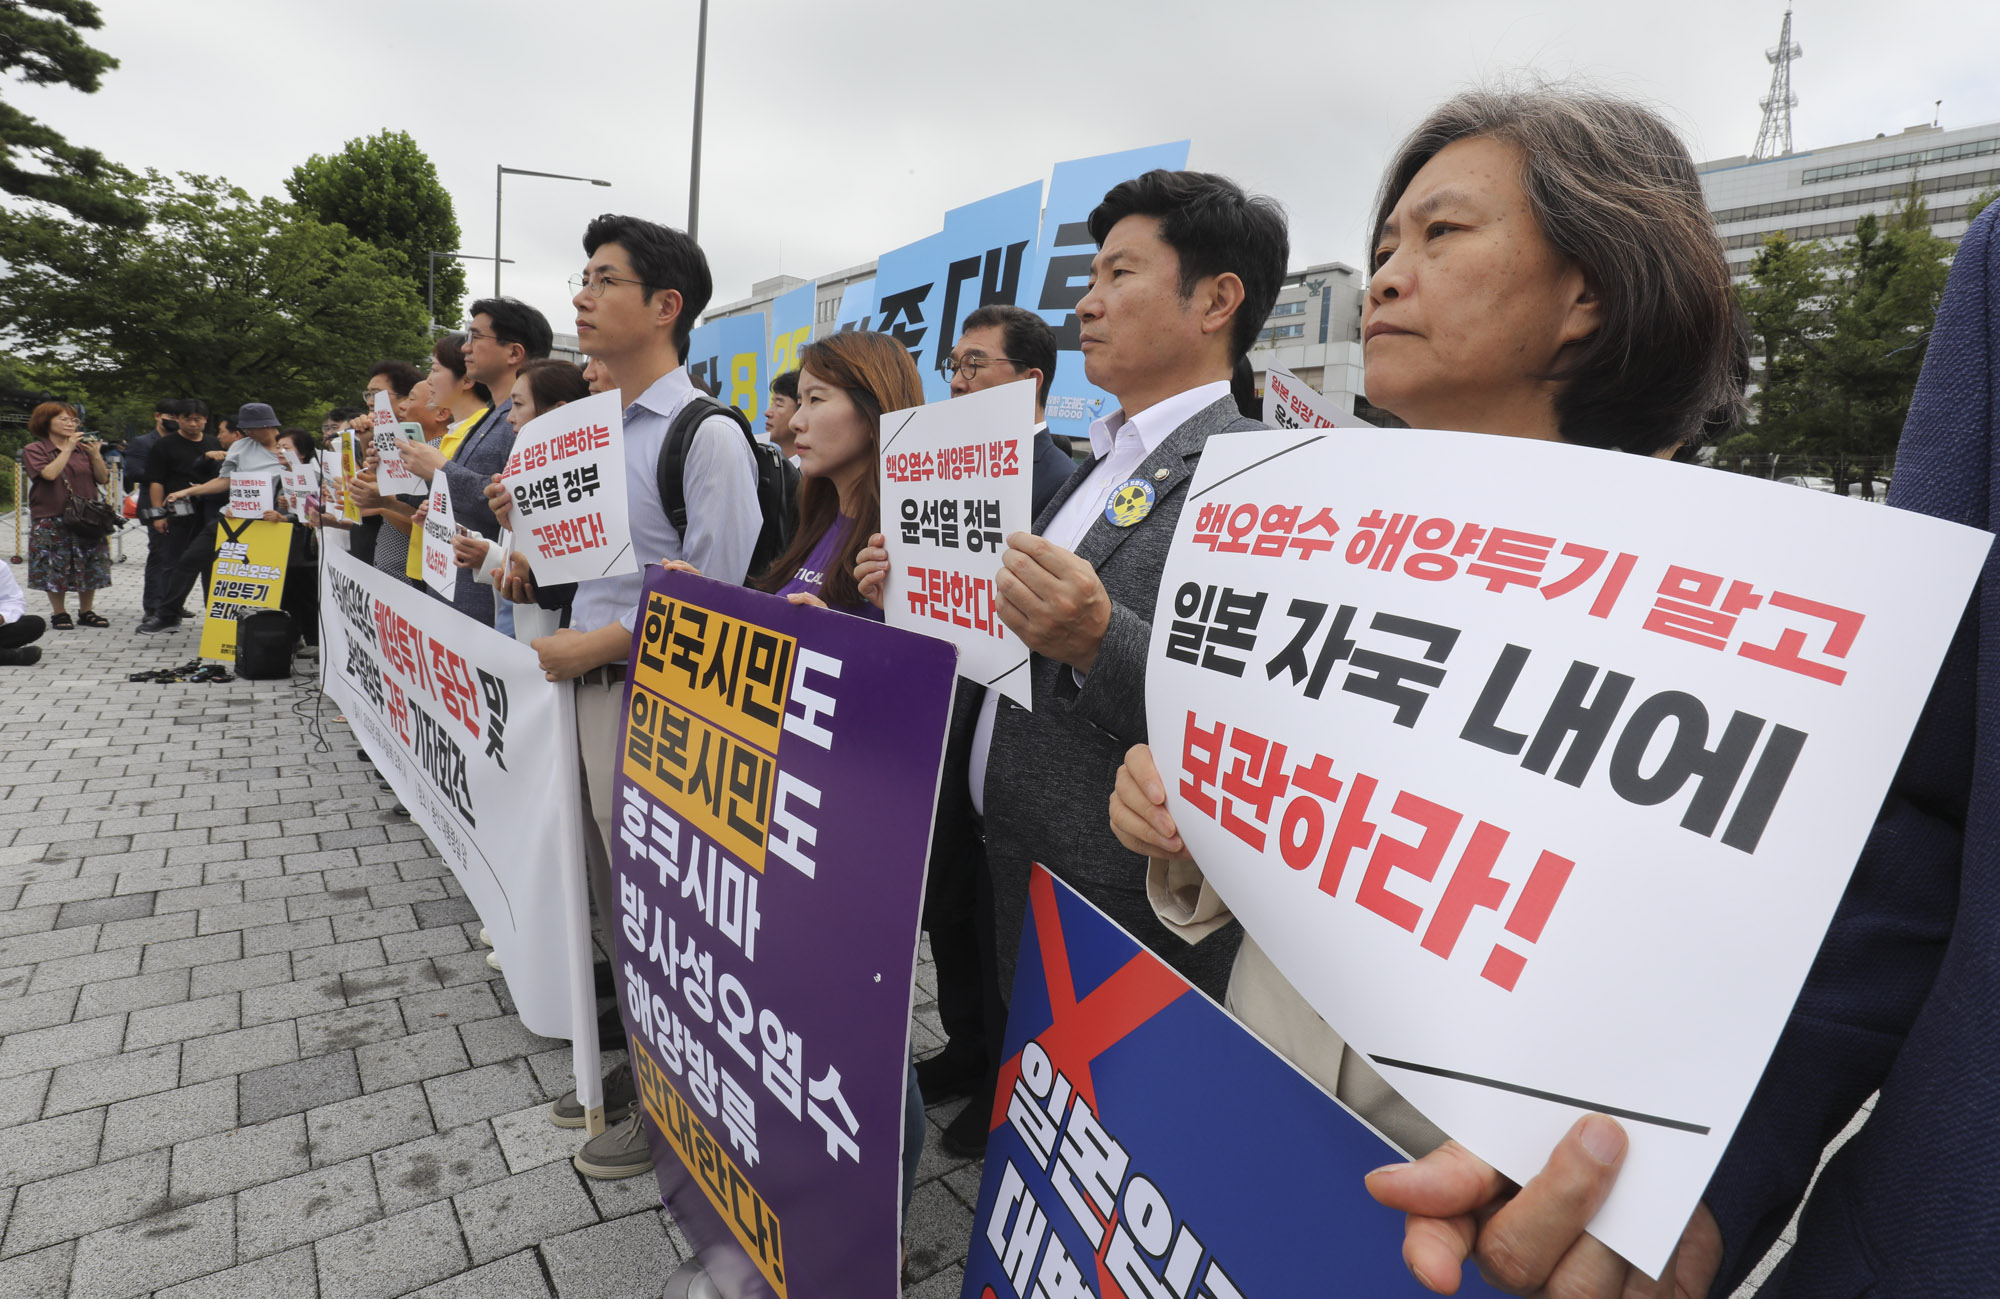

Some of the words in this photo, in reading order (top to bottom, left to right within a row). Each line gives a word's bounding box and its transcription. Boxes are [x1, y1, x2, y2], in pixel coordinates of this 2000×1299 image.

[524, 442, 547, 472] 입장
[550, 424, 610, 461] 대변하는
[886, 451, 934, 483] 핵오염수
[937, 442, 987, 481] 해양투기
[989, 439, 1019, 479] 방조
[1271, 375, 1290, 403] 일본
[1290, 395, 1314, 423] 입장
[218, 541, 249, 560] 일본
[514, 475, 562, 516] 윤석열
[562, 463, 600, 503] 정부
[532, 512, 607, 559] 규탄한다!
[900, 498, 960, 549] 윤석열
[963, 499, 1003, 554] 정부
[213, 580, 270, 601] 해양투기
[216, 561, 282, 580] 방사성오염수
[1192, 502, 1341, 561] 핵오염수
[1345, 509, 1639, 620] 해양투기
[1642, 564, 1866, 686] 말고
[374, 599, 438, 702] 해양투기
[428, 636, 481, 741] 중단
[475, 667, 509, 773] 및
[382, 671, 411, 748] 규탄
[407, 697, 476, 830] 기자회견
[640, 596, 843, 750] 한국시민도
[1165, 581, 1269, 679] 일본
[1265, 598, 1462, 729] 자국
[1459, 643, 1809, 855] 내에
[628, 692, 822, 880] 일본시민도
[1179, 710, 1576, 993] 보관하라!
[620, 785, 761, 962] 후쿠시마
[620, 872, 860, 1164] 방사성오염수
[624, 960, 760, 1168] 해양방류
[635, 1040, 784, 1285] 반대한다!
